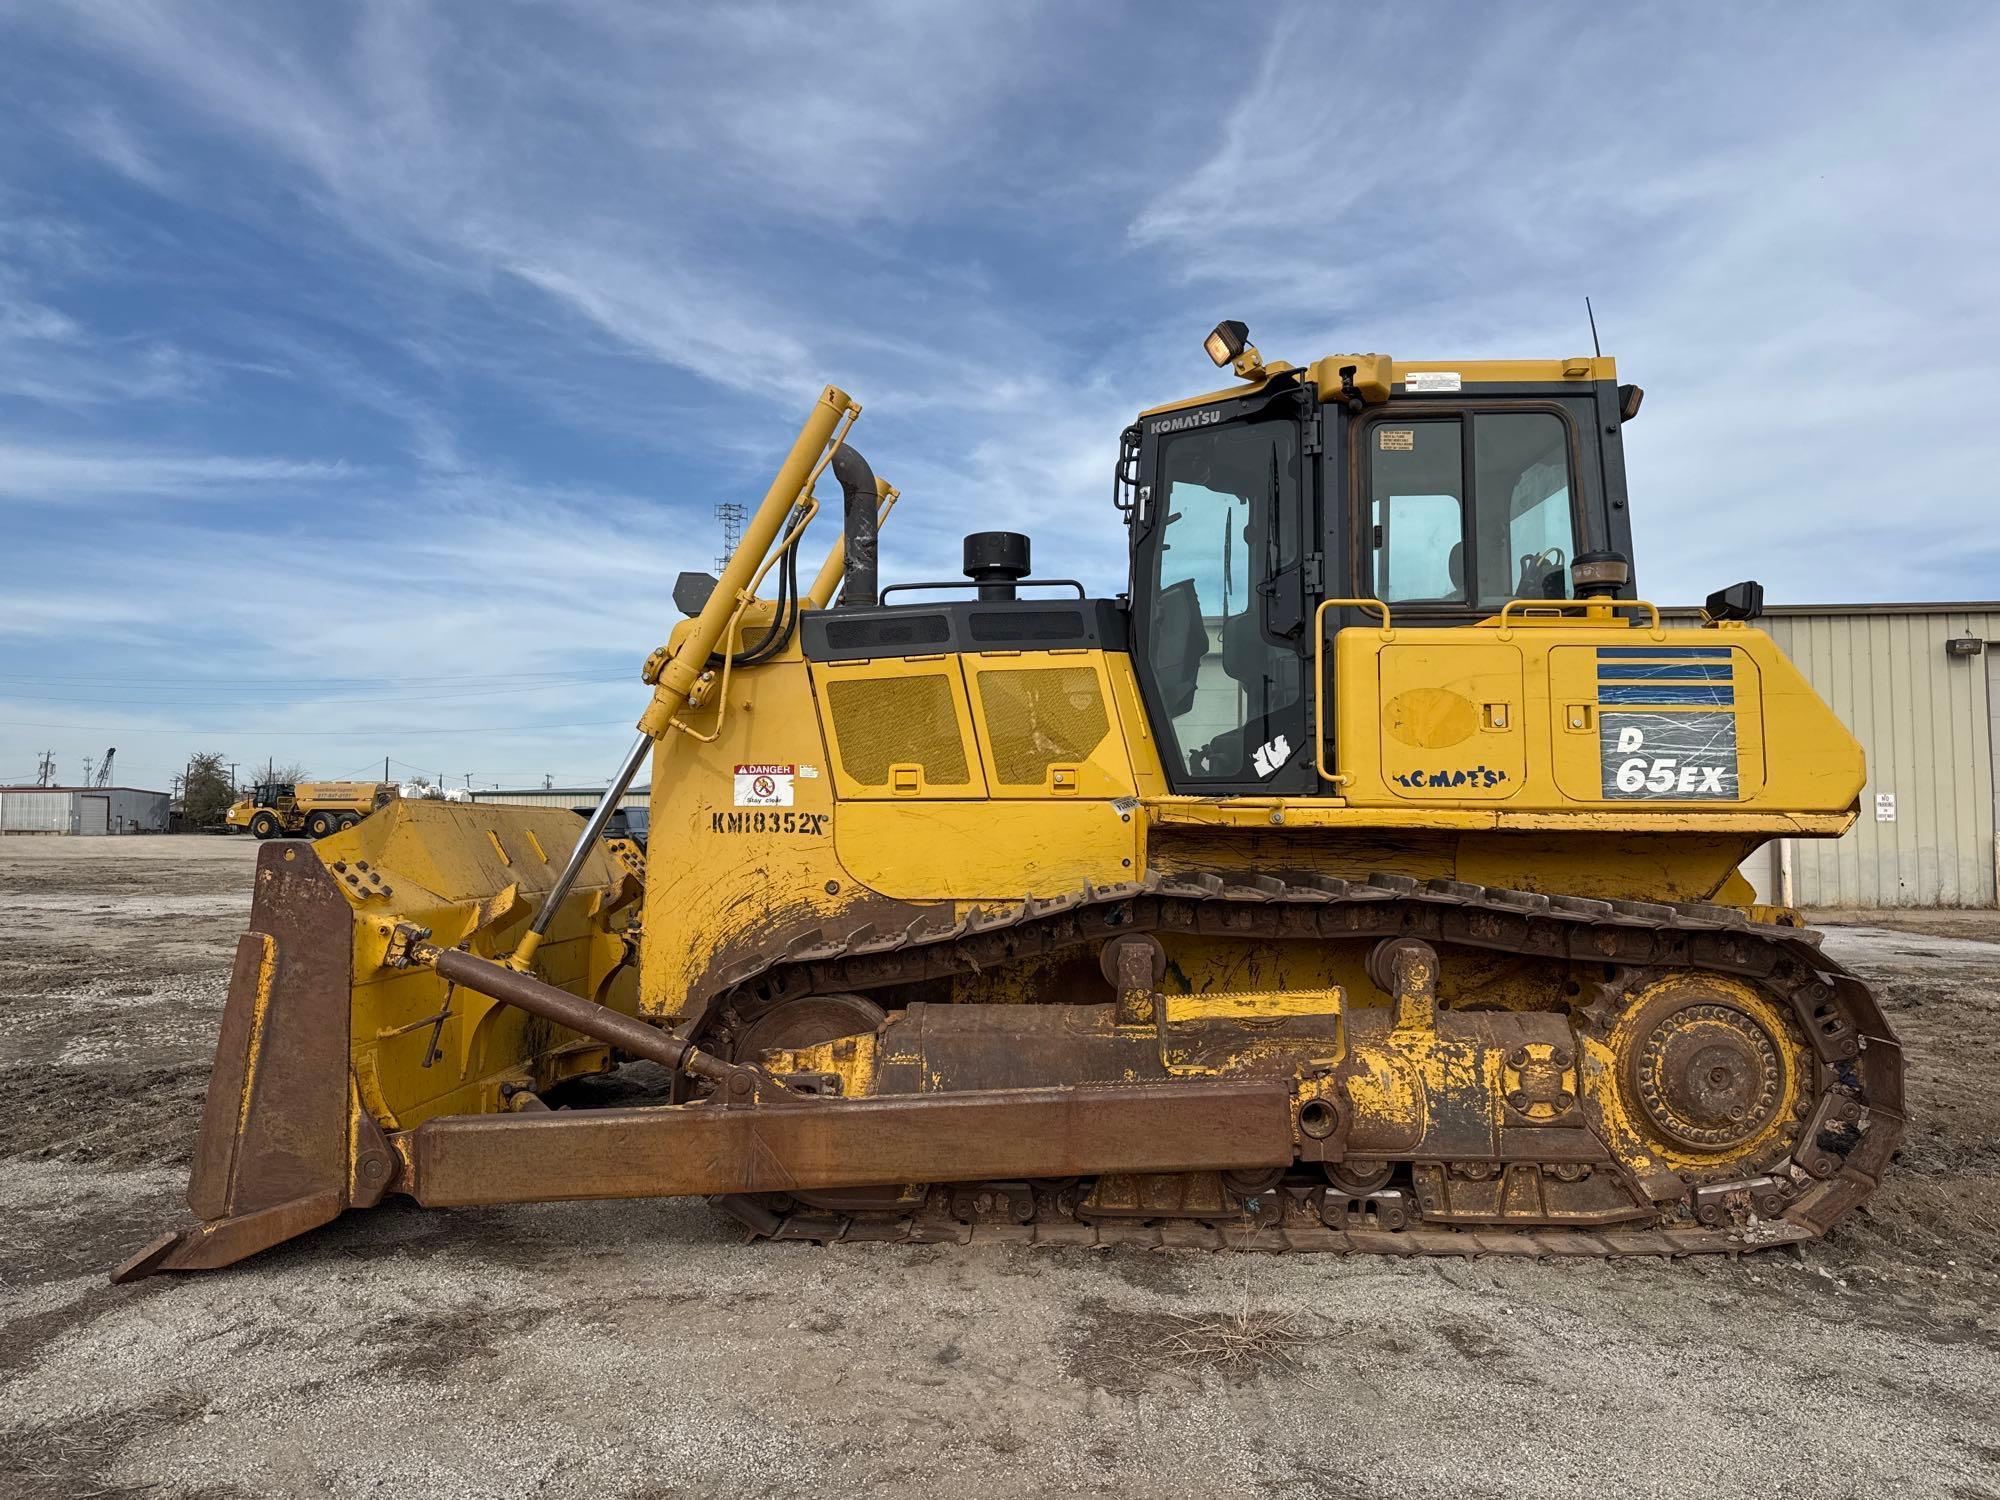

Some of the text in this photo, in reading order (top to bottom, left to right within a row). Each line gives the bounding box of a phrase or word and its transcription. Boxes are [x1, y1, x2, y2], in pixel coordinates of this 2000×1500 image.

[1151, 411, 1220, 434] KOMATSU
[1617, 727, 1644, 753] D
[749, 766, 791, 774] DANGER
[1616, 758, 1726, 793] 65EX
